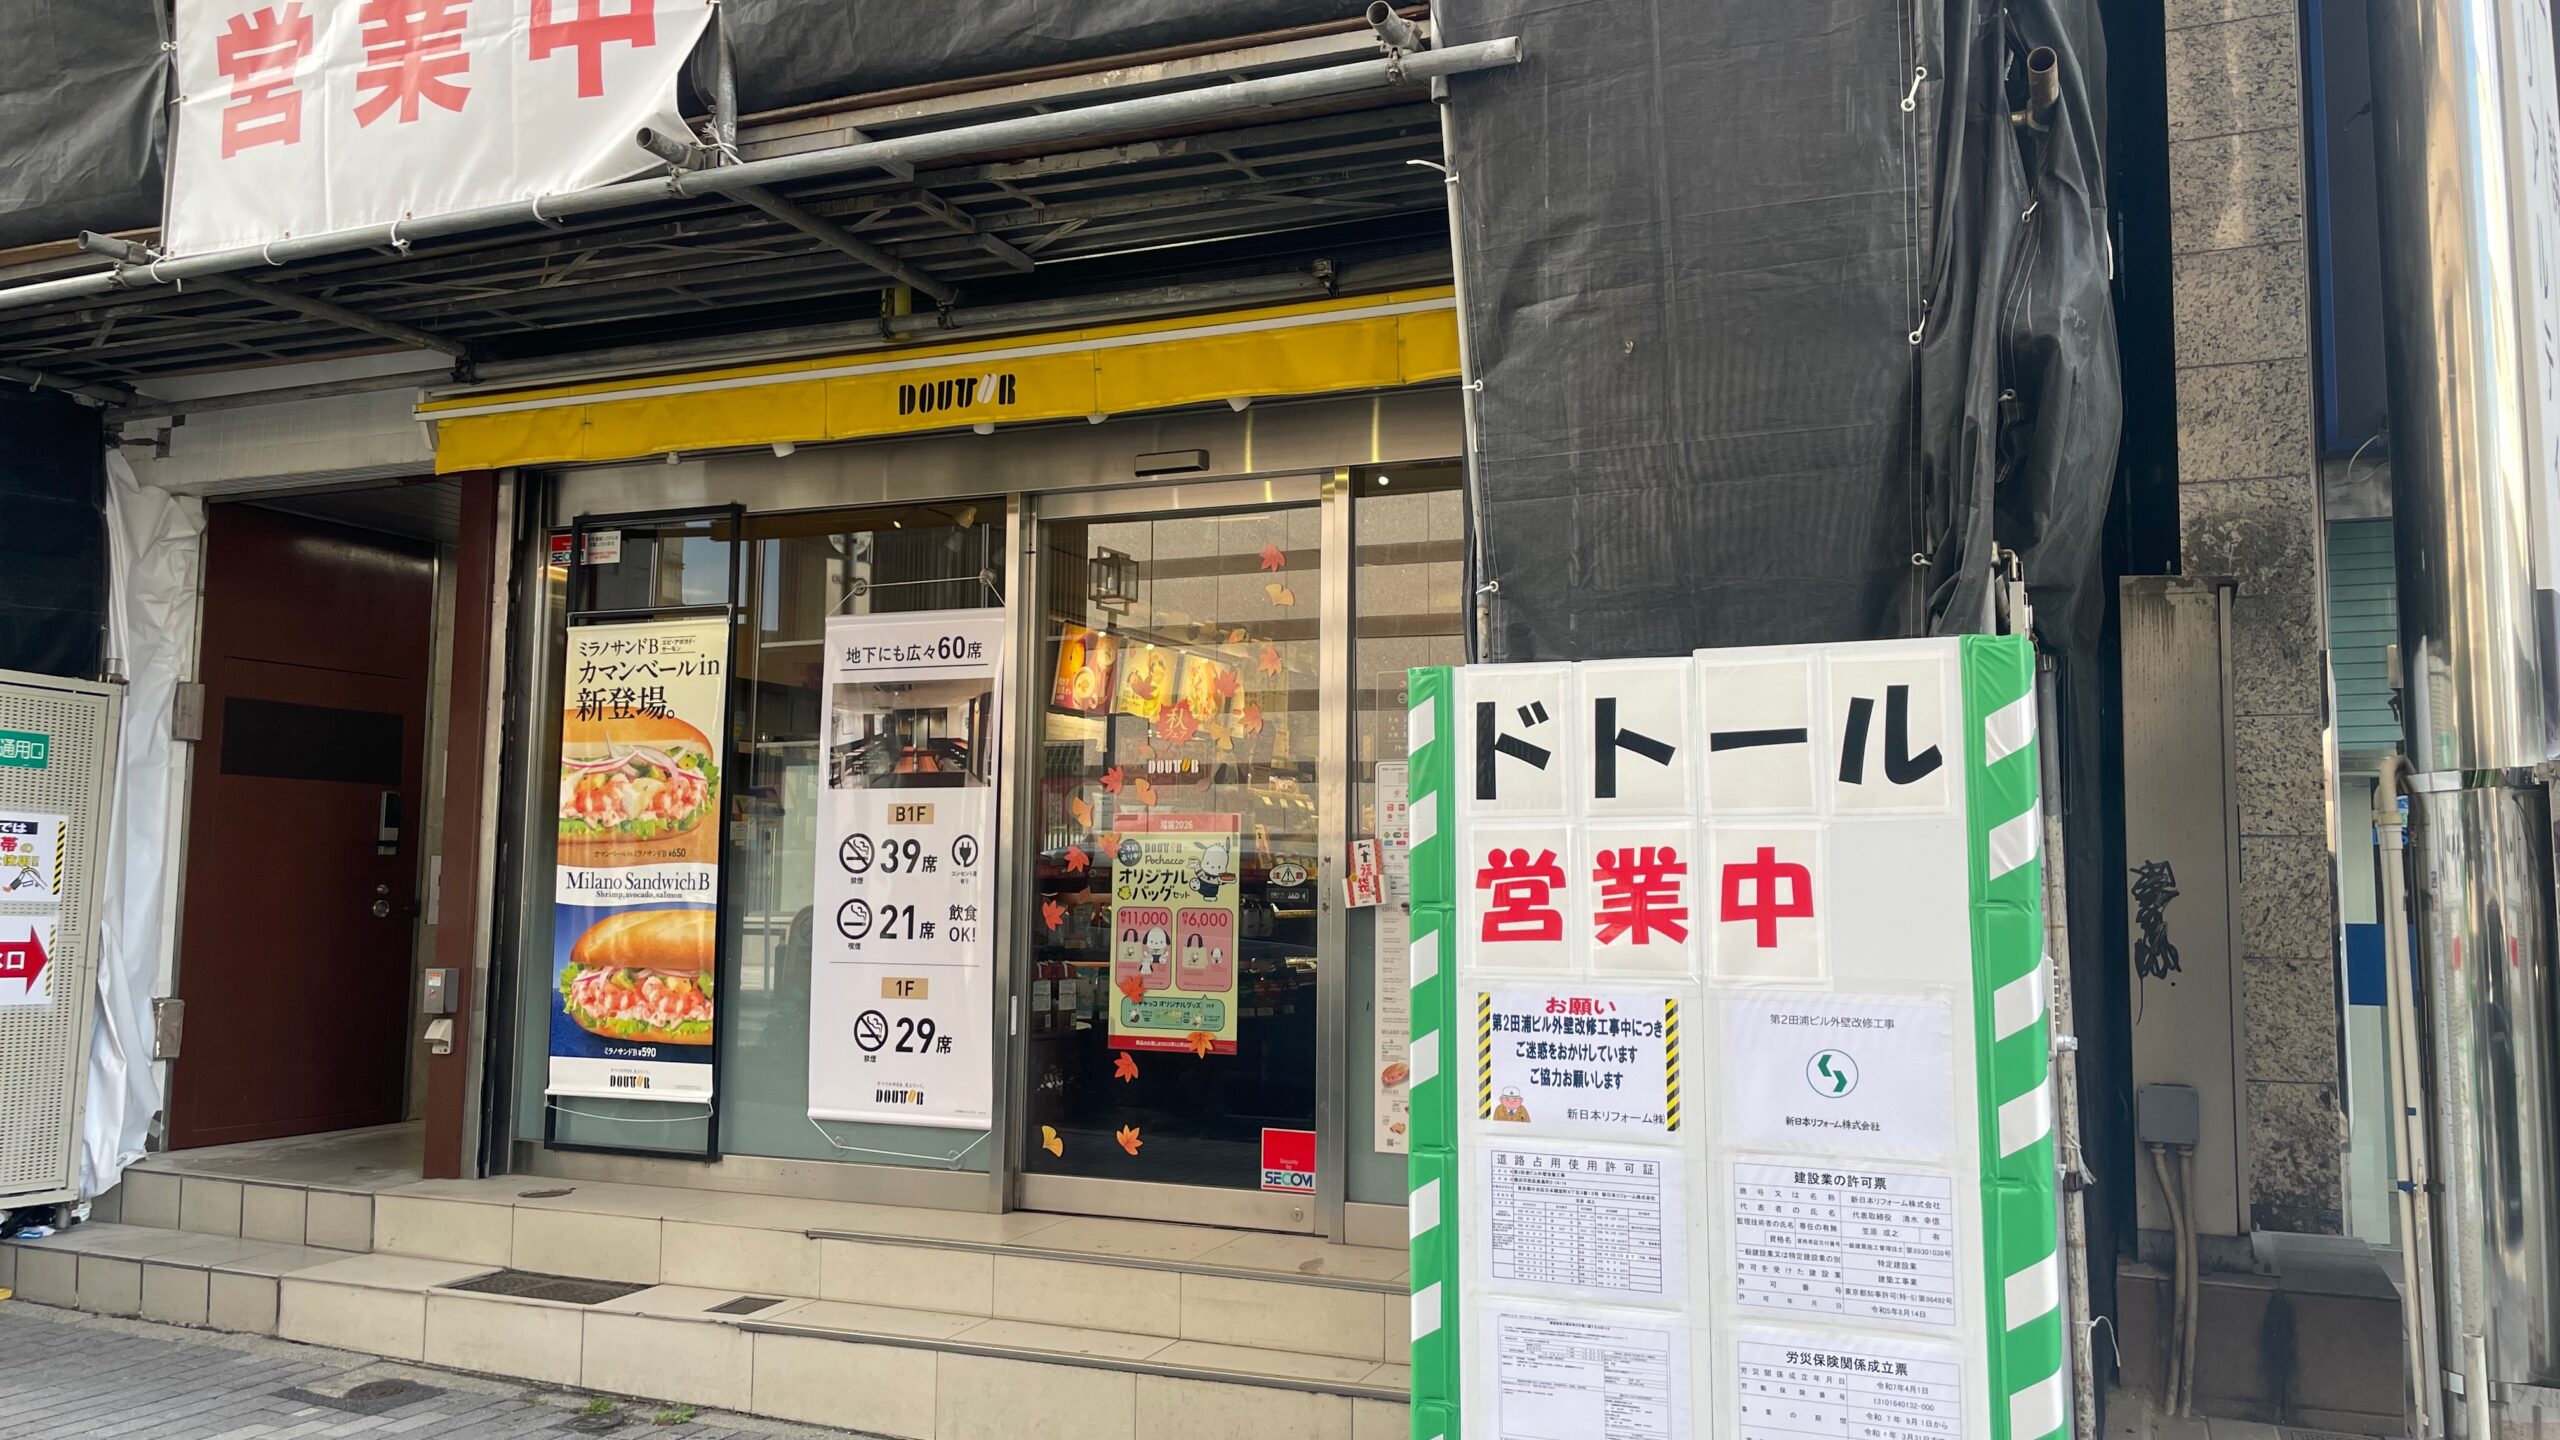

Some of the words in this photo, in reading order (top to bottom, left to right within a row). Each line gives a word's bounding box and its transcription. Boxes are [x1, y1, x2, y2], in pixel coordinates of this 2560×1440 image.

[216, 0, 657, 160] 営業中
[899, 373, 1016, 415] DOUTOR
[579, 638, 659, 657] ミラノサンドB
[846, 636, 982, 664] 地下にも広々60席
[577, 653, 720, 684] カマンベールin
[575, 686, 675, 721] 新登場。
[1167, 707, 1185, 729] 秋
[1476, 684, 1943, 800] ドトール
[1148, 758, 1199, 774] DOUTOR
[895, 806, 926, 822] B1F
[880, 838, 938, 874] 39席
[1145, 855, 1184, 865] Pochacco
[566, 872, 623, 890] Milano
[624, 872, 697, 891] Sandwich
[699, 873, 710, 890] B
[850, 877, 864, 885] 禁煙
[1119, 868, 1189, 884] オリジナル
[1475, 846, 1815, 949] 営業中
[879, 904, 935, 940] 21席
[949, 904, 977, 922] 飲食
[949, 927, 976, 943] OK!
[848, 942, 861, 950] 喫煙
[0, 951, 25, 970] 口
[896, 980, 915, 997] 1F
[1545, 997, 1617, 1016] お願い
[1492, 1013, 1663, 1039] 第2田浦ビル外壁改修工事中につき
[1769, 1014, 1895, 1030] 第2田浦ビル外壁改修工事
[895, 1017, 952, 1055] 29席
[864, 1055, 877, 1063] 禁煙
[1516, 1041, 1638, 1064] ご迷惑をおかけしています
[610, 1074, 650, 1089] DOUTOR
[1530, 1067, 1624, 1090] ご協力お願いします
[876, 1088, 924, 1105] DOUTOR
[1785, 1116, 1881, 1131] 新日本リフォーム株式会社
[1497, 1153, 1654, 1176] 道路占用使用許可証
[1265, 1171, 1312, 1187] SECOM
[1794, 1171, 1887, 1190] 建設業の許可票
[1851, 1195, 1941, 1210] 新日本リフォーム株式会社
[1852, 1211, 1892, 1222] 代表取締役
[1799, 1222, 1838, 1233] 専任の有無
[1932, 1233, 1940, 1241] 有
[1769, 1234, 1792, 1245] 資格名
[1786, 1351, 1908, 1377] 労災保険関係成立票
